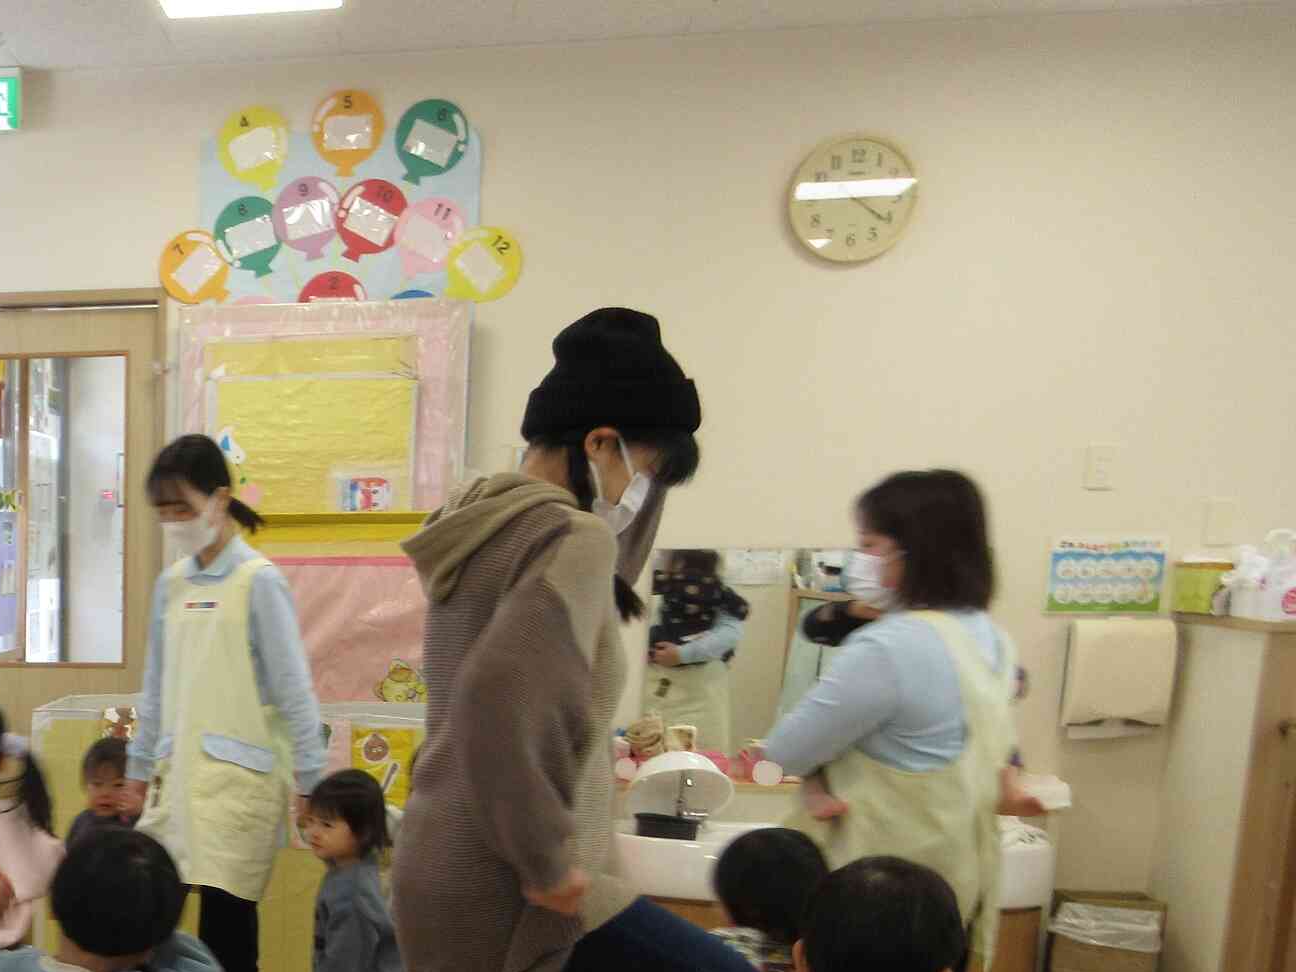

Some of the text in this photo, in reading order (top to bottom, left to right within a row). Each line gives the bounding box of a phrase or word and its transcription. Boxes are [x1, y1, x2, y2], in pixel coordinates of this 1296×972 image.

[343, 95, 353, 109] 5
[298, 183, 308, 197] 9
[375, 186, 394, 202] 10
[433, 203, 451, 220] 11
[491, 235, 510, 254] 12
[845, 232, 856, 247] 6
